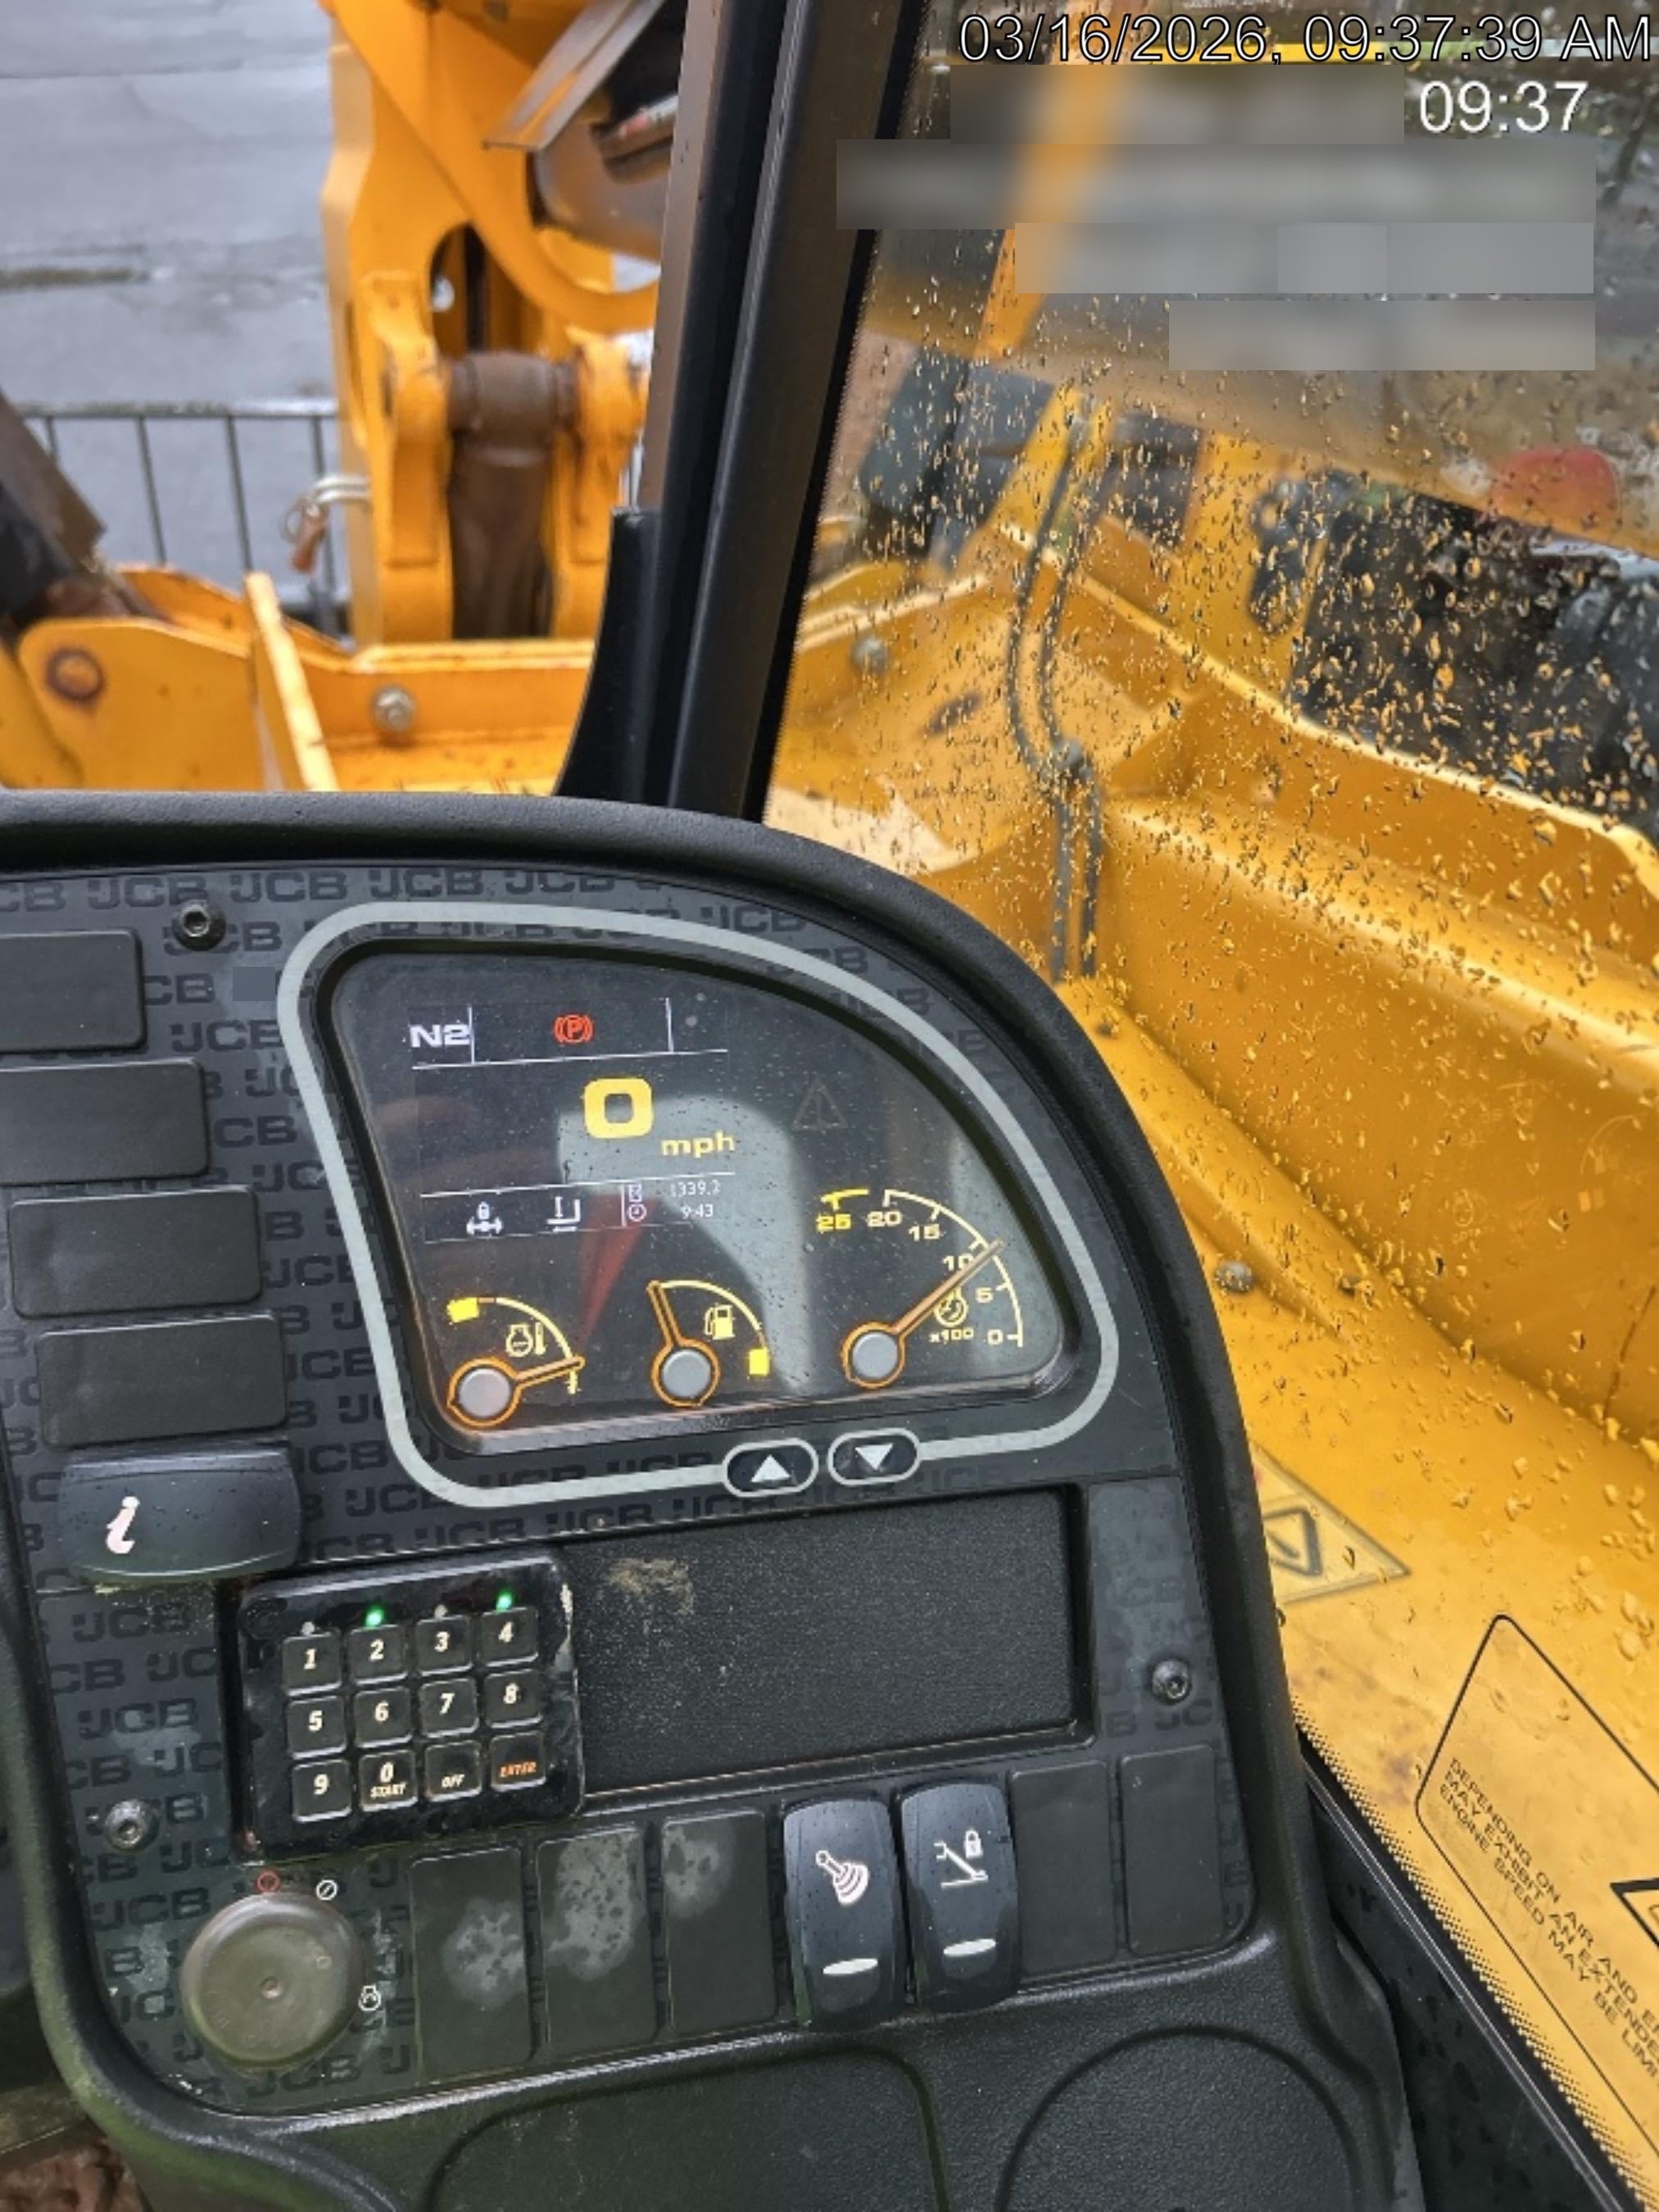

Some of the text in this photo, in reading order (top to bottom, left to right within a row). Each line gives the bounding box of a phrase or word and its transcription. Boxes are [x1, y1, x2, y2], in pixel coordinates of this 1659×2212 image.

[87, 876, 210, 910] JCB
[229, 872, 347, 902] JCB
[369, 868, 484, 899] JCB
[144, 972, 215, 1006] CB
[410, 1022, 471, 1048] N2
[213, 1115, 298, 1149] CB
[582, 1077, 736, 1158] 0 mph
[816, 1213, 852, 1231] 25
[867, 1210, 903, 1228] 20
[908, 1223, 941, 1242] 15
[975, 1286, 994, 1304] 5
[986, 1328, 1004, 1346] 0
[71, 1603, 192, 1643] JCB
[303, 1621, 514, 1670] 1 2 3 4
[50, 1646, 217, 1695] CB JC
[77, 1697, 200, 1742] JCB
[308, 1683, 519, 1732] 5 6 7 8
[153, 1742, 222, 1779] JC
[314, 1761, 395, 1794] 9 0
[370, 1761, 537, 1799] START OFF ENTER
[159, 1840, 231, 1874] JC
[1449, 1756, 1532, 1867] DEPENDING
[1536, 1871, 1561, 1903] ON
[1563, 1911, 1593, 1947] AIR
[1598, 1956, 1638, 2004] AND
[92, 1886, 212, 1933] JCB
[1445, 1770, 1659, 2065] MAY EXHIBIT AN EXTENDE
[1440, 1784, 1658, 2078] ENGINE SPEED MAY BE LIMI
